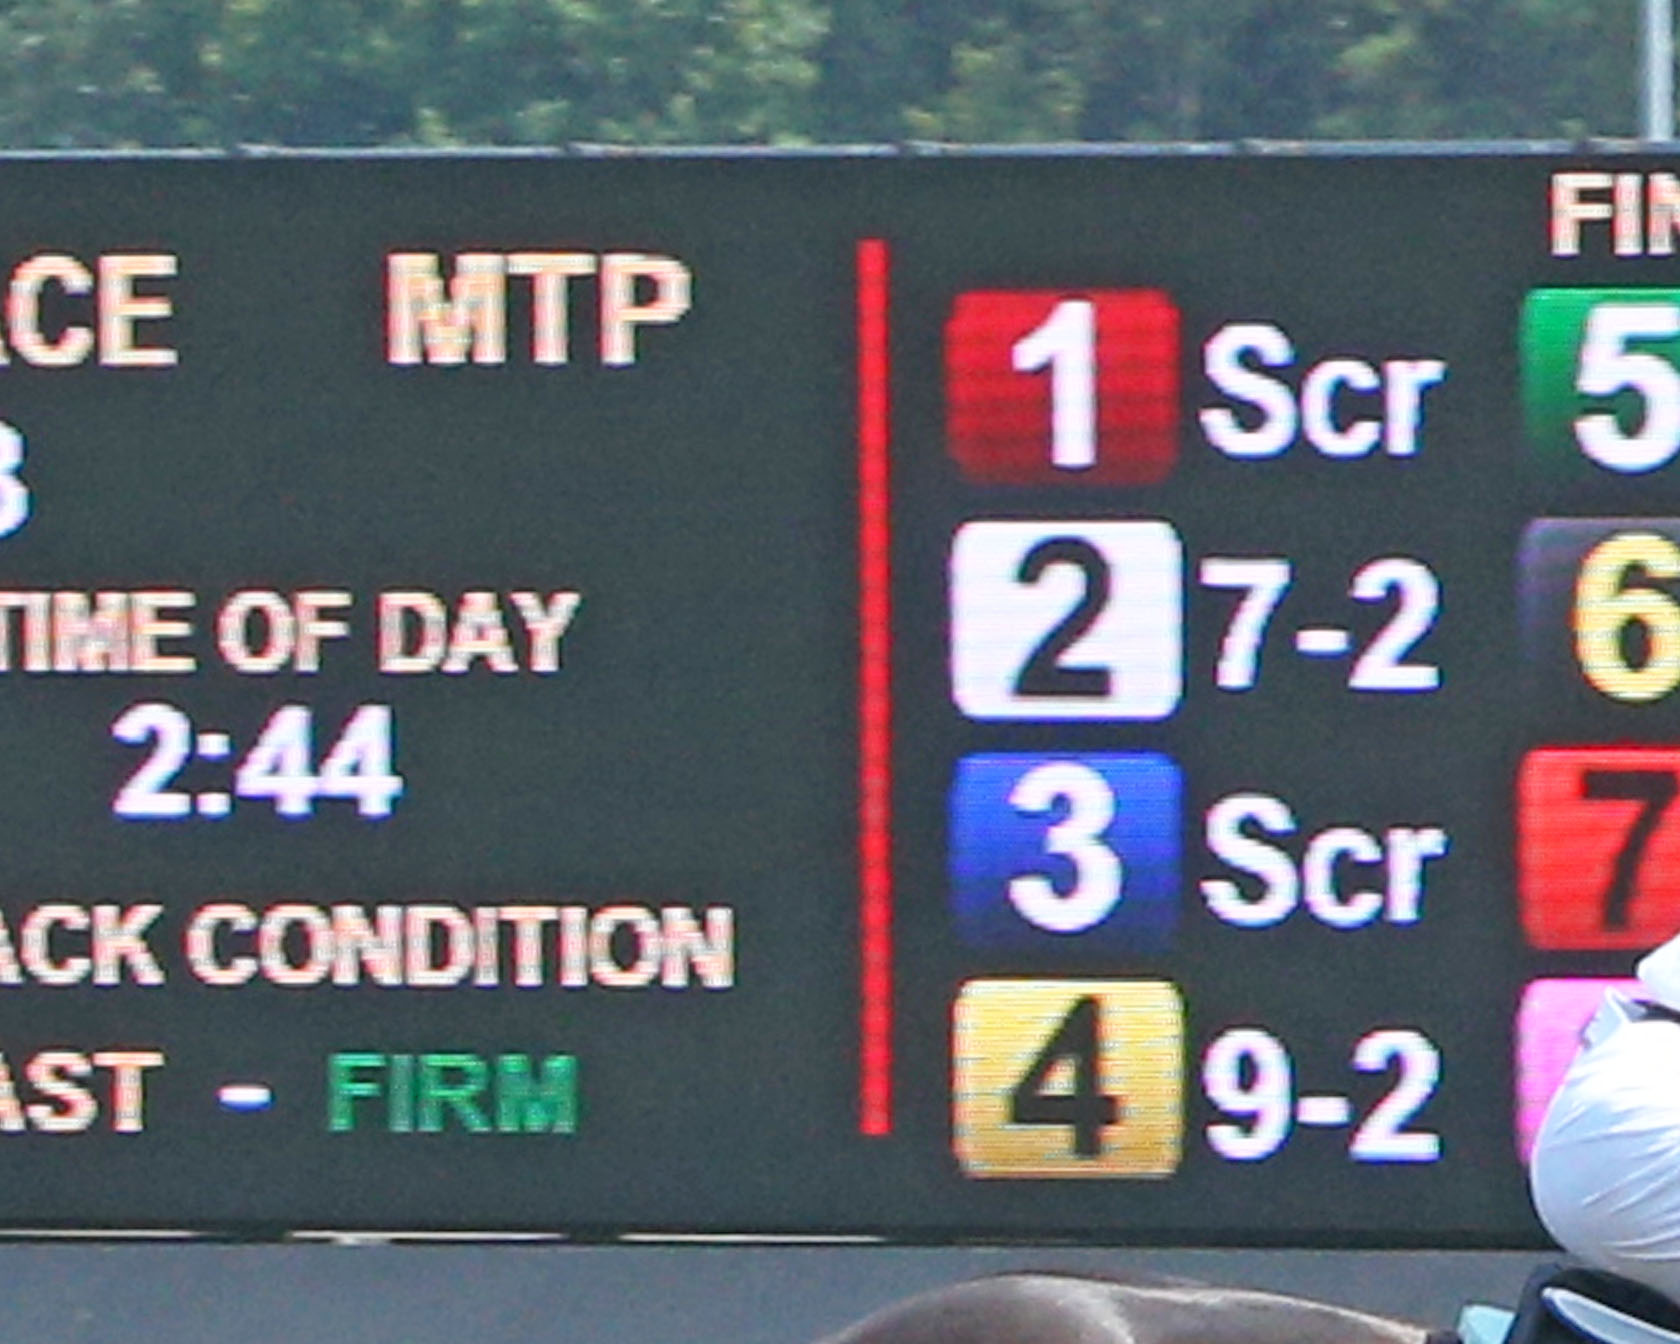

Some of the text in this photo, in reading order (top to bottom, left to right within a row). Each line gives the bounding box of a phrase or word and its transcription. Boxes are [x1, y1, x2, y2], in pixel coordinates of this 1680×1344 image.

[0, 254, 178, 366] CE
[387, 253, 691, 366] MTP
[1012, 299, 1446, 468] 1 Scr
[217, 591, 351, 673] OF
[378, 592, 580, 673] DAY
[1010, 535, 1441, 697] 2 7-2
[112, 703, 402, 818] 2:44
[1009, 762, 1448, 932] 3 Scr
[1581, 769, 1680, 926] 7
[0, 903, 735, 988] CK CONDITION
[0, 1051, 165, 1132] ST
[327, 1053, 579, 1133] FIRM
[1007, 994, 1441, 1162] 4 9-2
